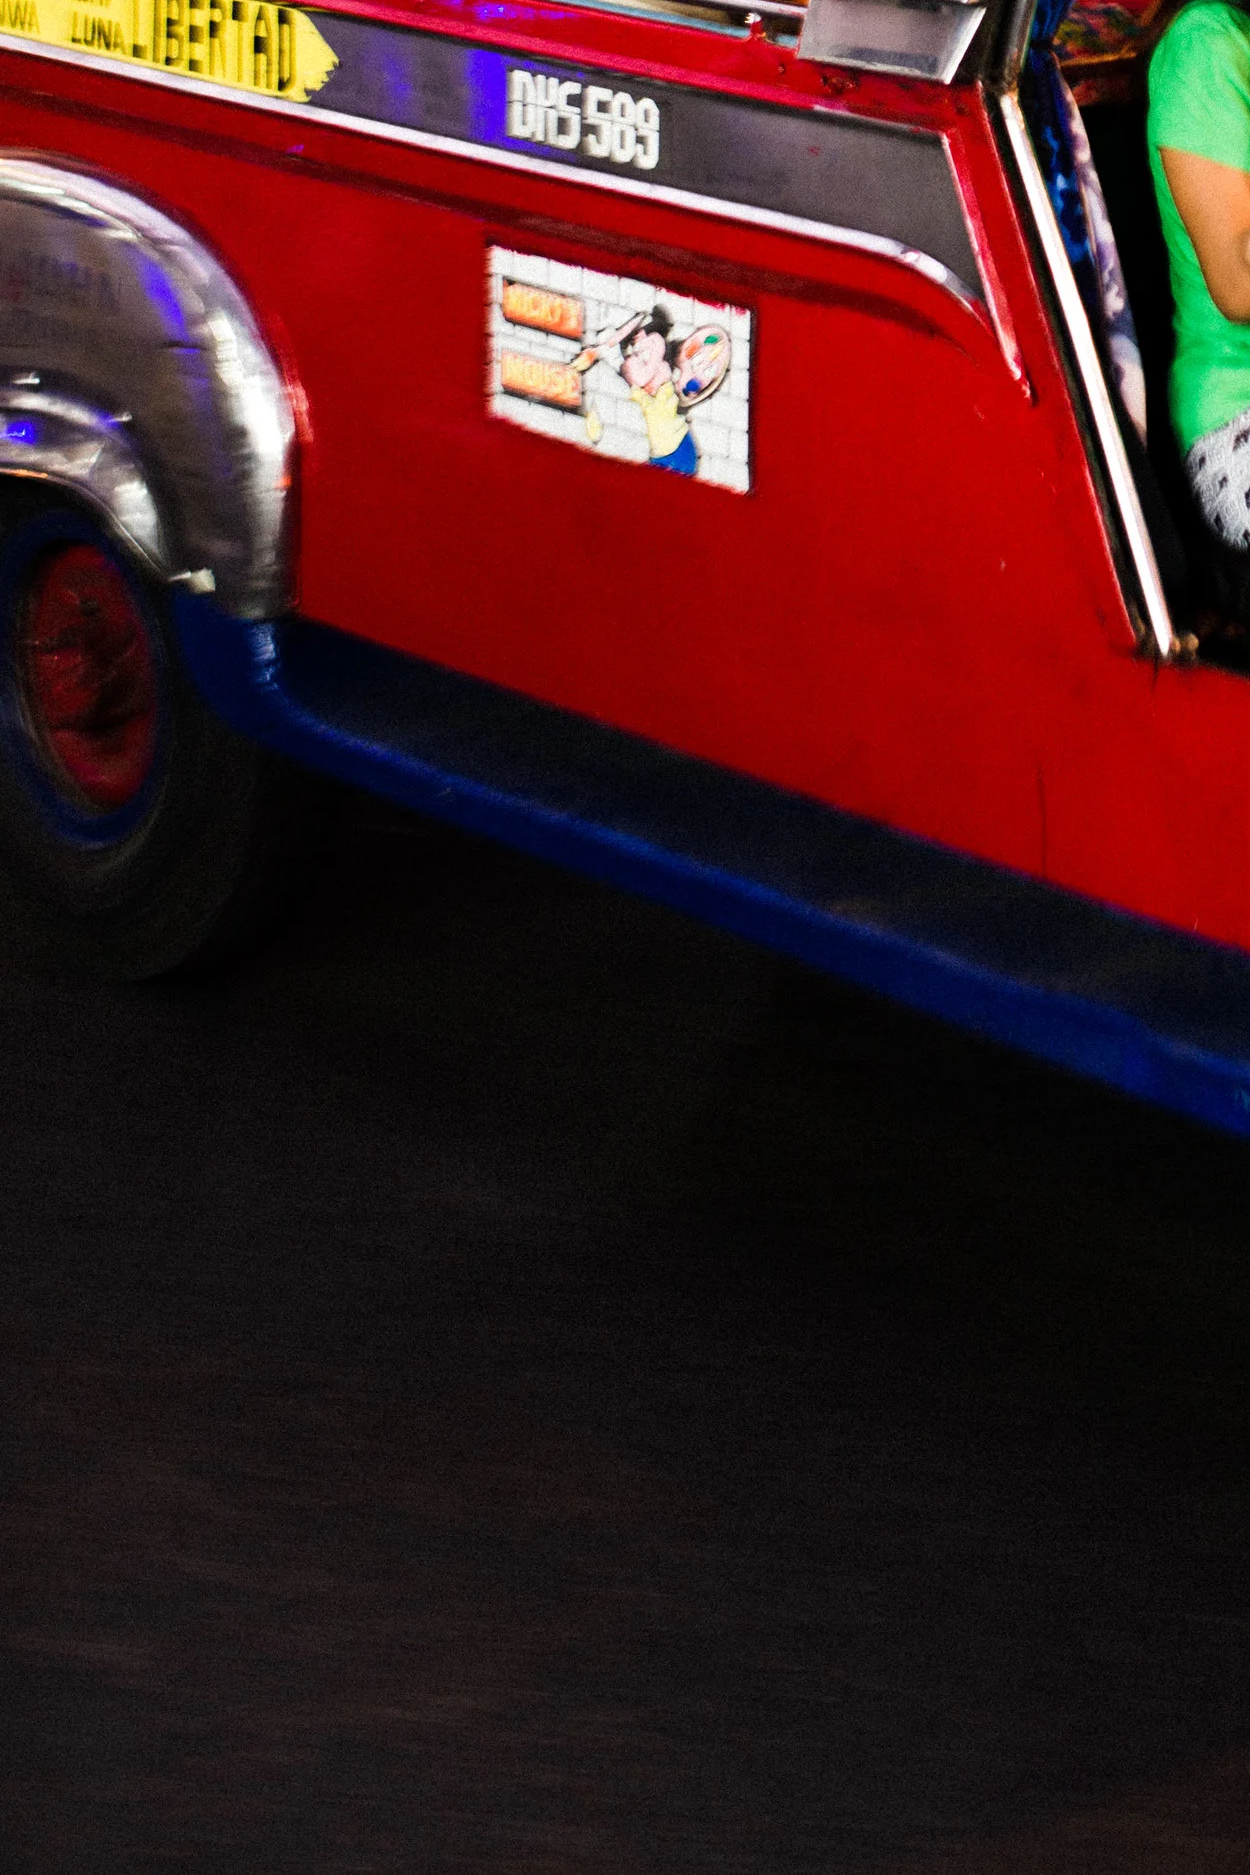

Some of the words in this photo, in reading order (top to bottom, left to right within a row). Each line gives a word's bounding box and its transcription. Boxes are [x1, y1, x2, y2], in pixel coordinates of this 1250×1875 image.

[71, 11, 126, 55] LUNA
[507, 69, 582, 150] DHS
[582, 85, 660, 170] 589
[503, 354, 581, 400] MOUSE
